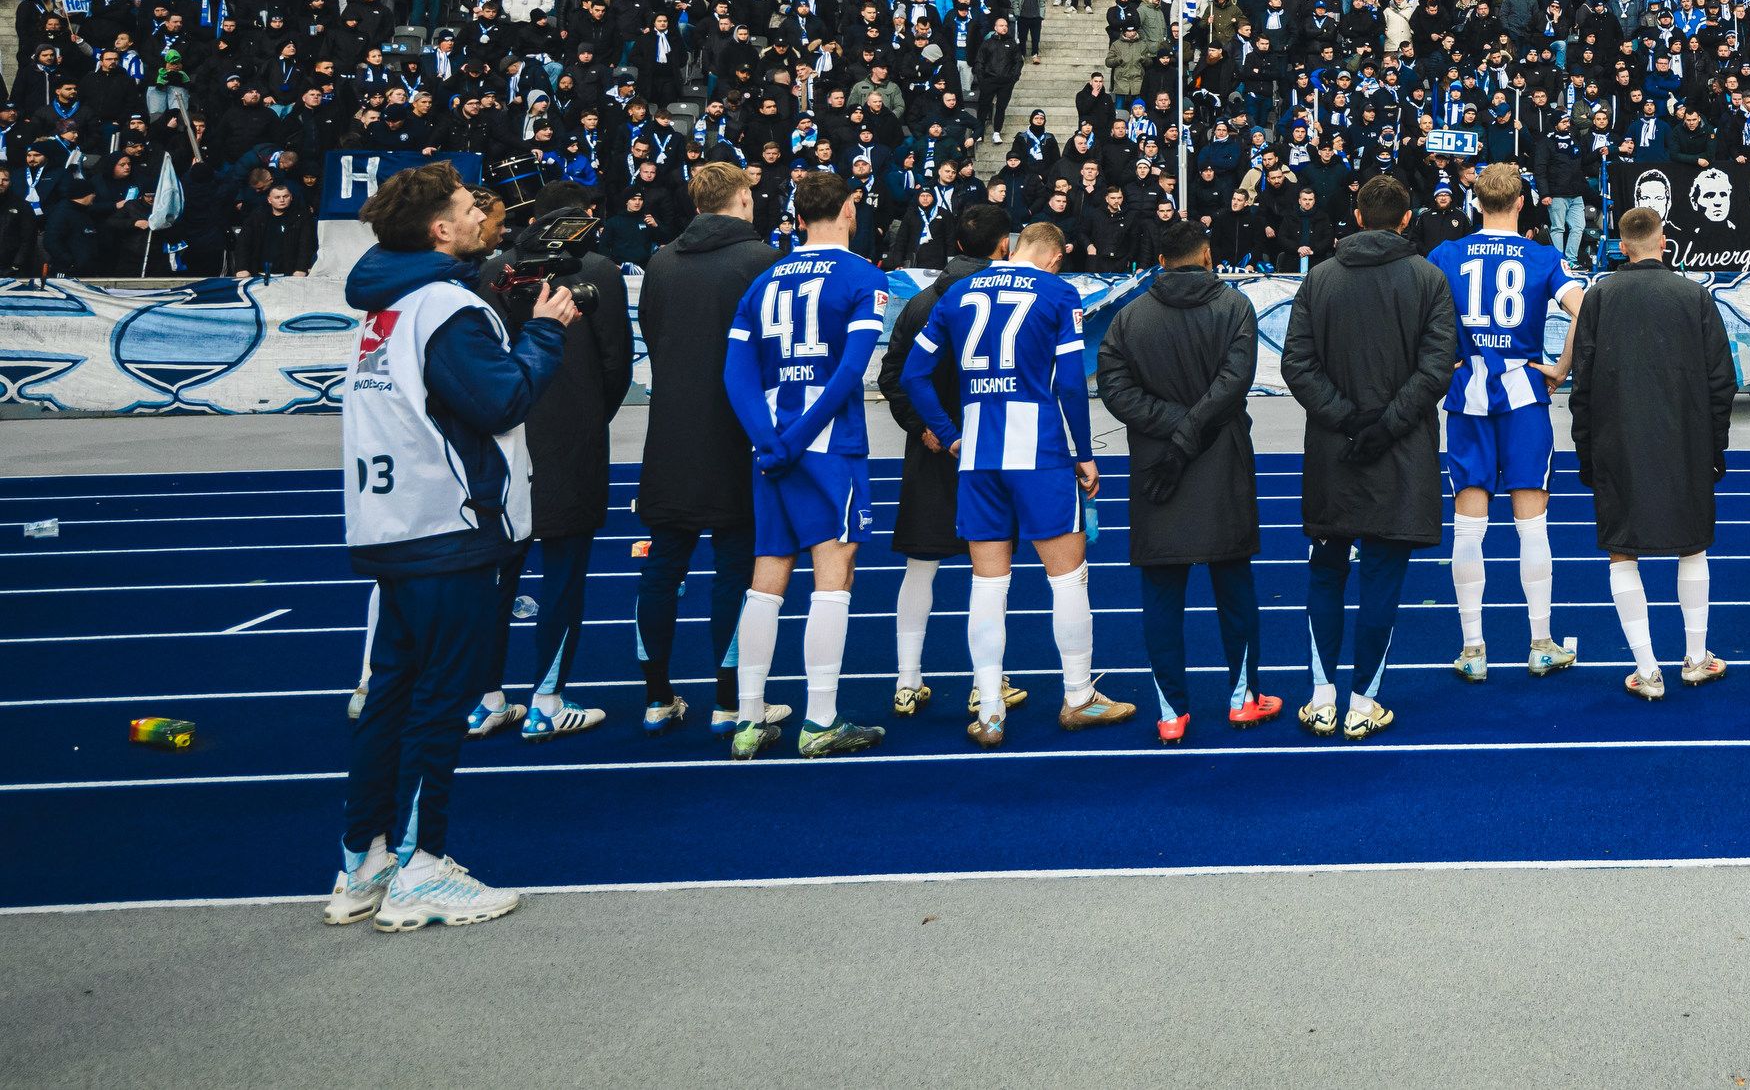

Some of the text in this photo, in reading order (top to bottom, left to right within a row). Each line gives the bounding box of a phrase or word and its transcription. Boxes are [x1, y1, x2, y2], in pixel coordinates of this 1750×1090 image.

[340, 155, 380, 198] H
[1467, 244, 1524, 258] HERTHA BSC
[773, 261, 836, 278] HERTHA BSC
[970, 275, 1037, 289] HERTHA BSC
[1460, 259, 1526, 329] 18
[761, 277, 829, 359] 41
[960, 290, 1037, 371] 27
[1472, 333, 1511, 348] SCHULER
